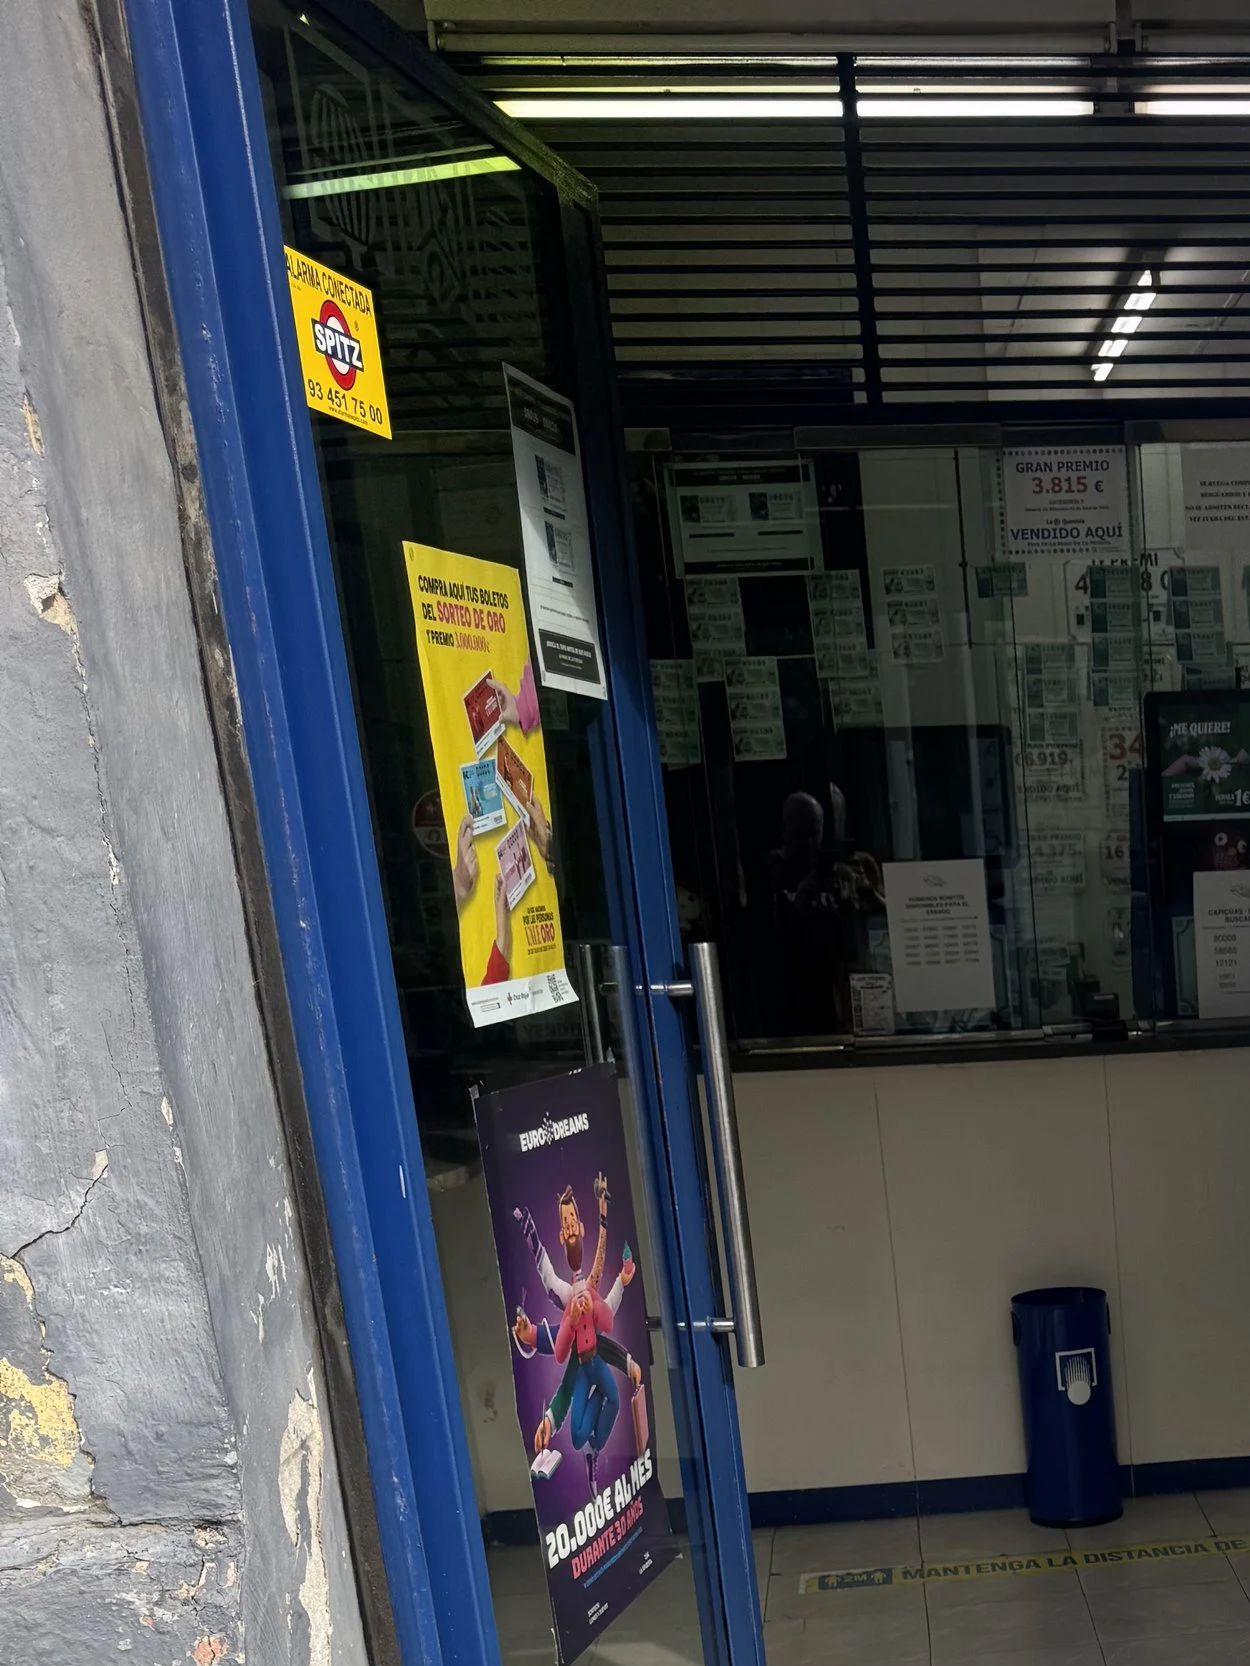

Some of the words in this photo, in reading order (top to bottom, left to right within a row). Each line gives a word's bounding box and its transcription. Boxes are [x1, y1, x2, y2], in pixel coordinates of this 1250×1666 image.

[285, 252, 321, 291] ALARMA
[322, 271, 372, 317] CONECTADA
[314, 323, 362, 368] SPITZ
[308, 379, 323, 401] 93
[327, 387, 348, 411] 451
[352, 397, 366, 418] 75
[370, 404, 382, 425] 00
[1015, 462, 1053, 473] GRAN
[1057, 460, 1110, 472] PREMIO
[1032, 476, 1088, 494] 3.815
[1095, 481, 1104, 493] €
[1011, 527, 1080, 541] VENDIDO
[1085, 522, 1123, 538] AQUÍ
[418, 575, 448, 597] COMPRA
[449, 581, 465, 602] AQUÍ
[466, 585, 479, 603] TUS
[479, 588, 509, 609] BOLETOS
[422, 602, 436, 621] DEL
[437, 600, 471, 628] SORTEO
[473, 608, 485, 630] DE
[487, 610, 506, 633] ORO
[431, 630, 454, 647] PREMIO
[1190, 721, 1231, 736] QUIERE!
[1235, 788, 1250, 806] 1€
[614, 1473, 631, 1513] AL
[629, 1448, 653, 1495] MES
[571, 1528, 616, 1580] DURANTE
[902, 1559, 1041, 1581] MANTENGA
[1047, 1555, 1079, 1567] LA
[1083, 1542, 1210, 1564] DISTANCIA
[1213, 1539, 1249, 1552] DE
